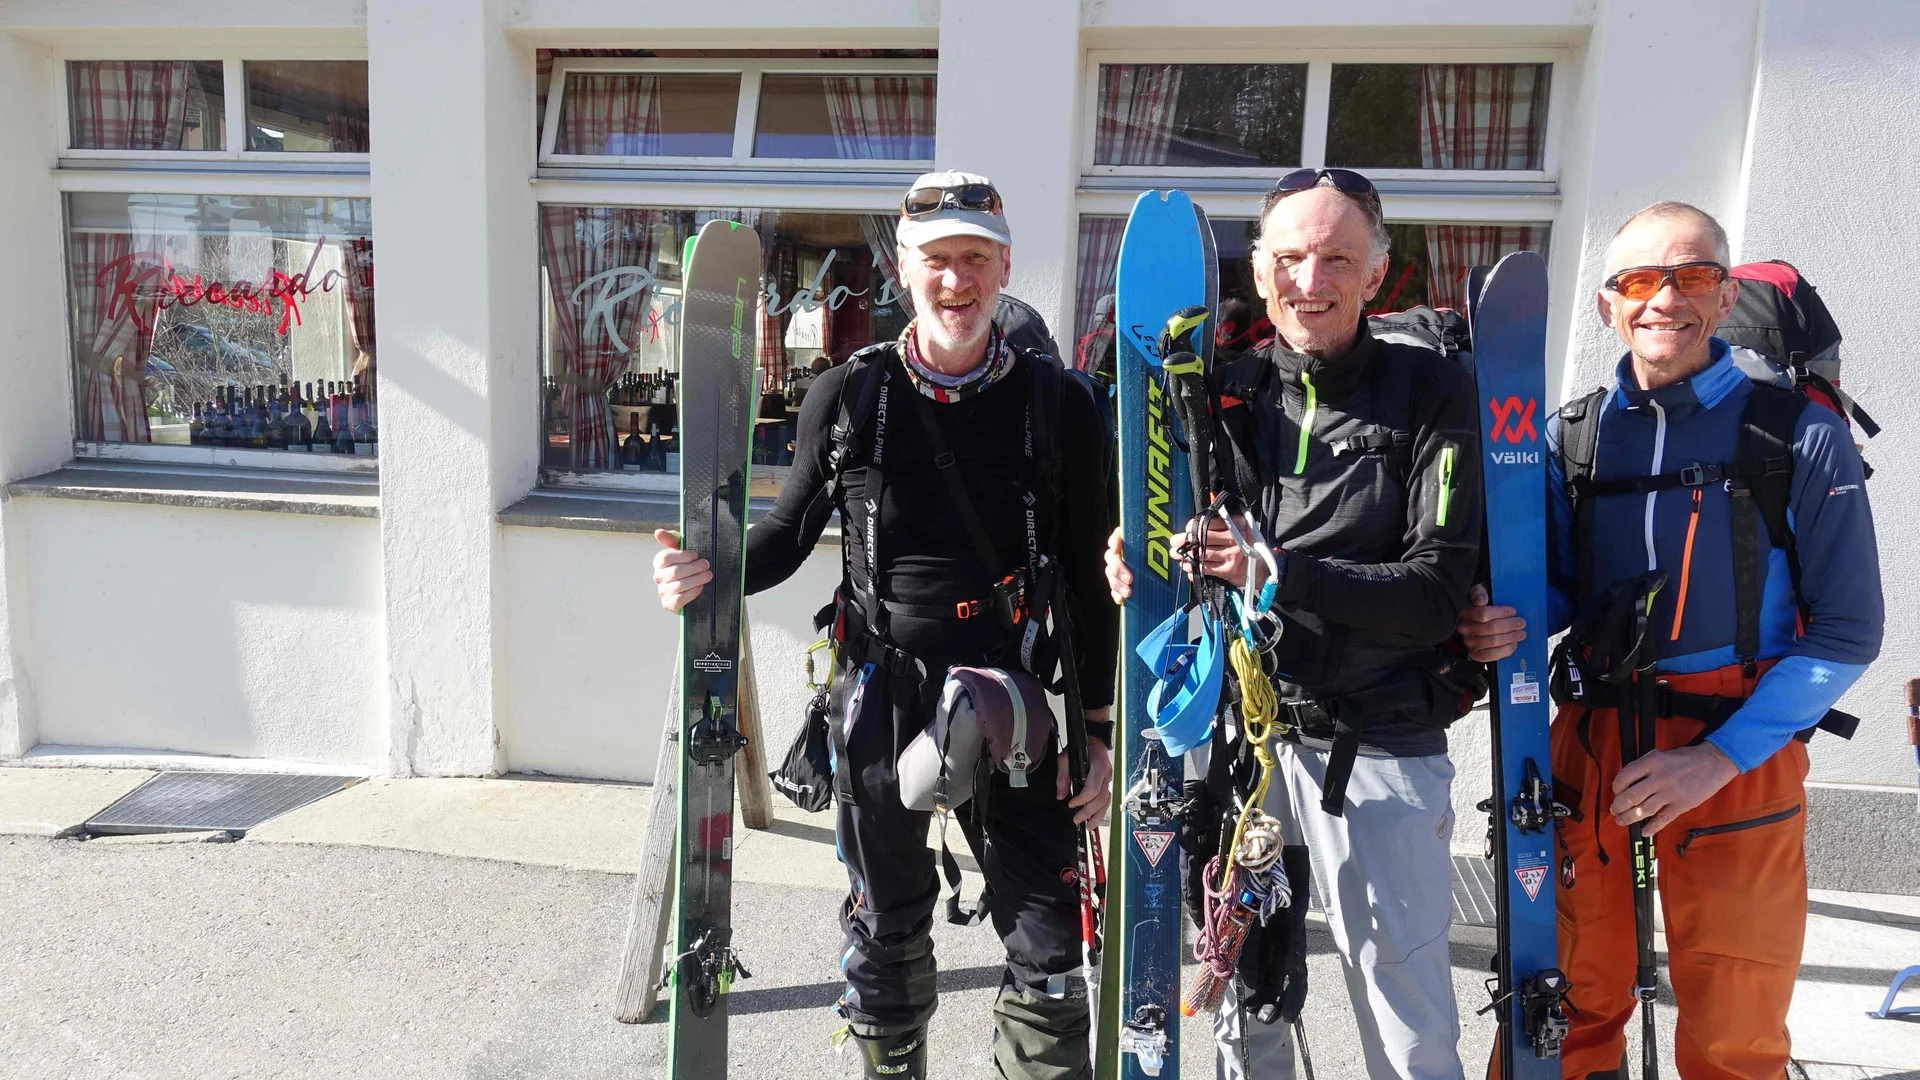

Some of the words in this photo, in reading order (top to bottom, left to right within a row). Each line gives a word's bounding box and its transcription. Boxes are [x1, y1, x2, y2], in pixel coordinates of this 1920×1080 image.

[572, 248, 909, 354] Ricrdo's
[730, 276, 747, 359] elan
[873, 385, 890, 465] DIRECTALPINE
[1490, 451, 1539, 465] Völkl
[1146, 376, 1170, 580] DYNAFIT
[866, 516, 874, 596] DIRECTALPINE
[1026, 509, 1037, 586] DIRECTALPIN
[774, 774, 813, 794] elan
[1634, 840, 1647, 889] LEKI
